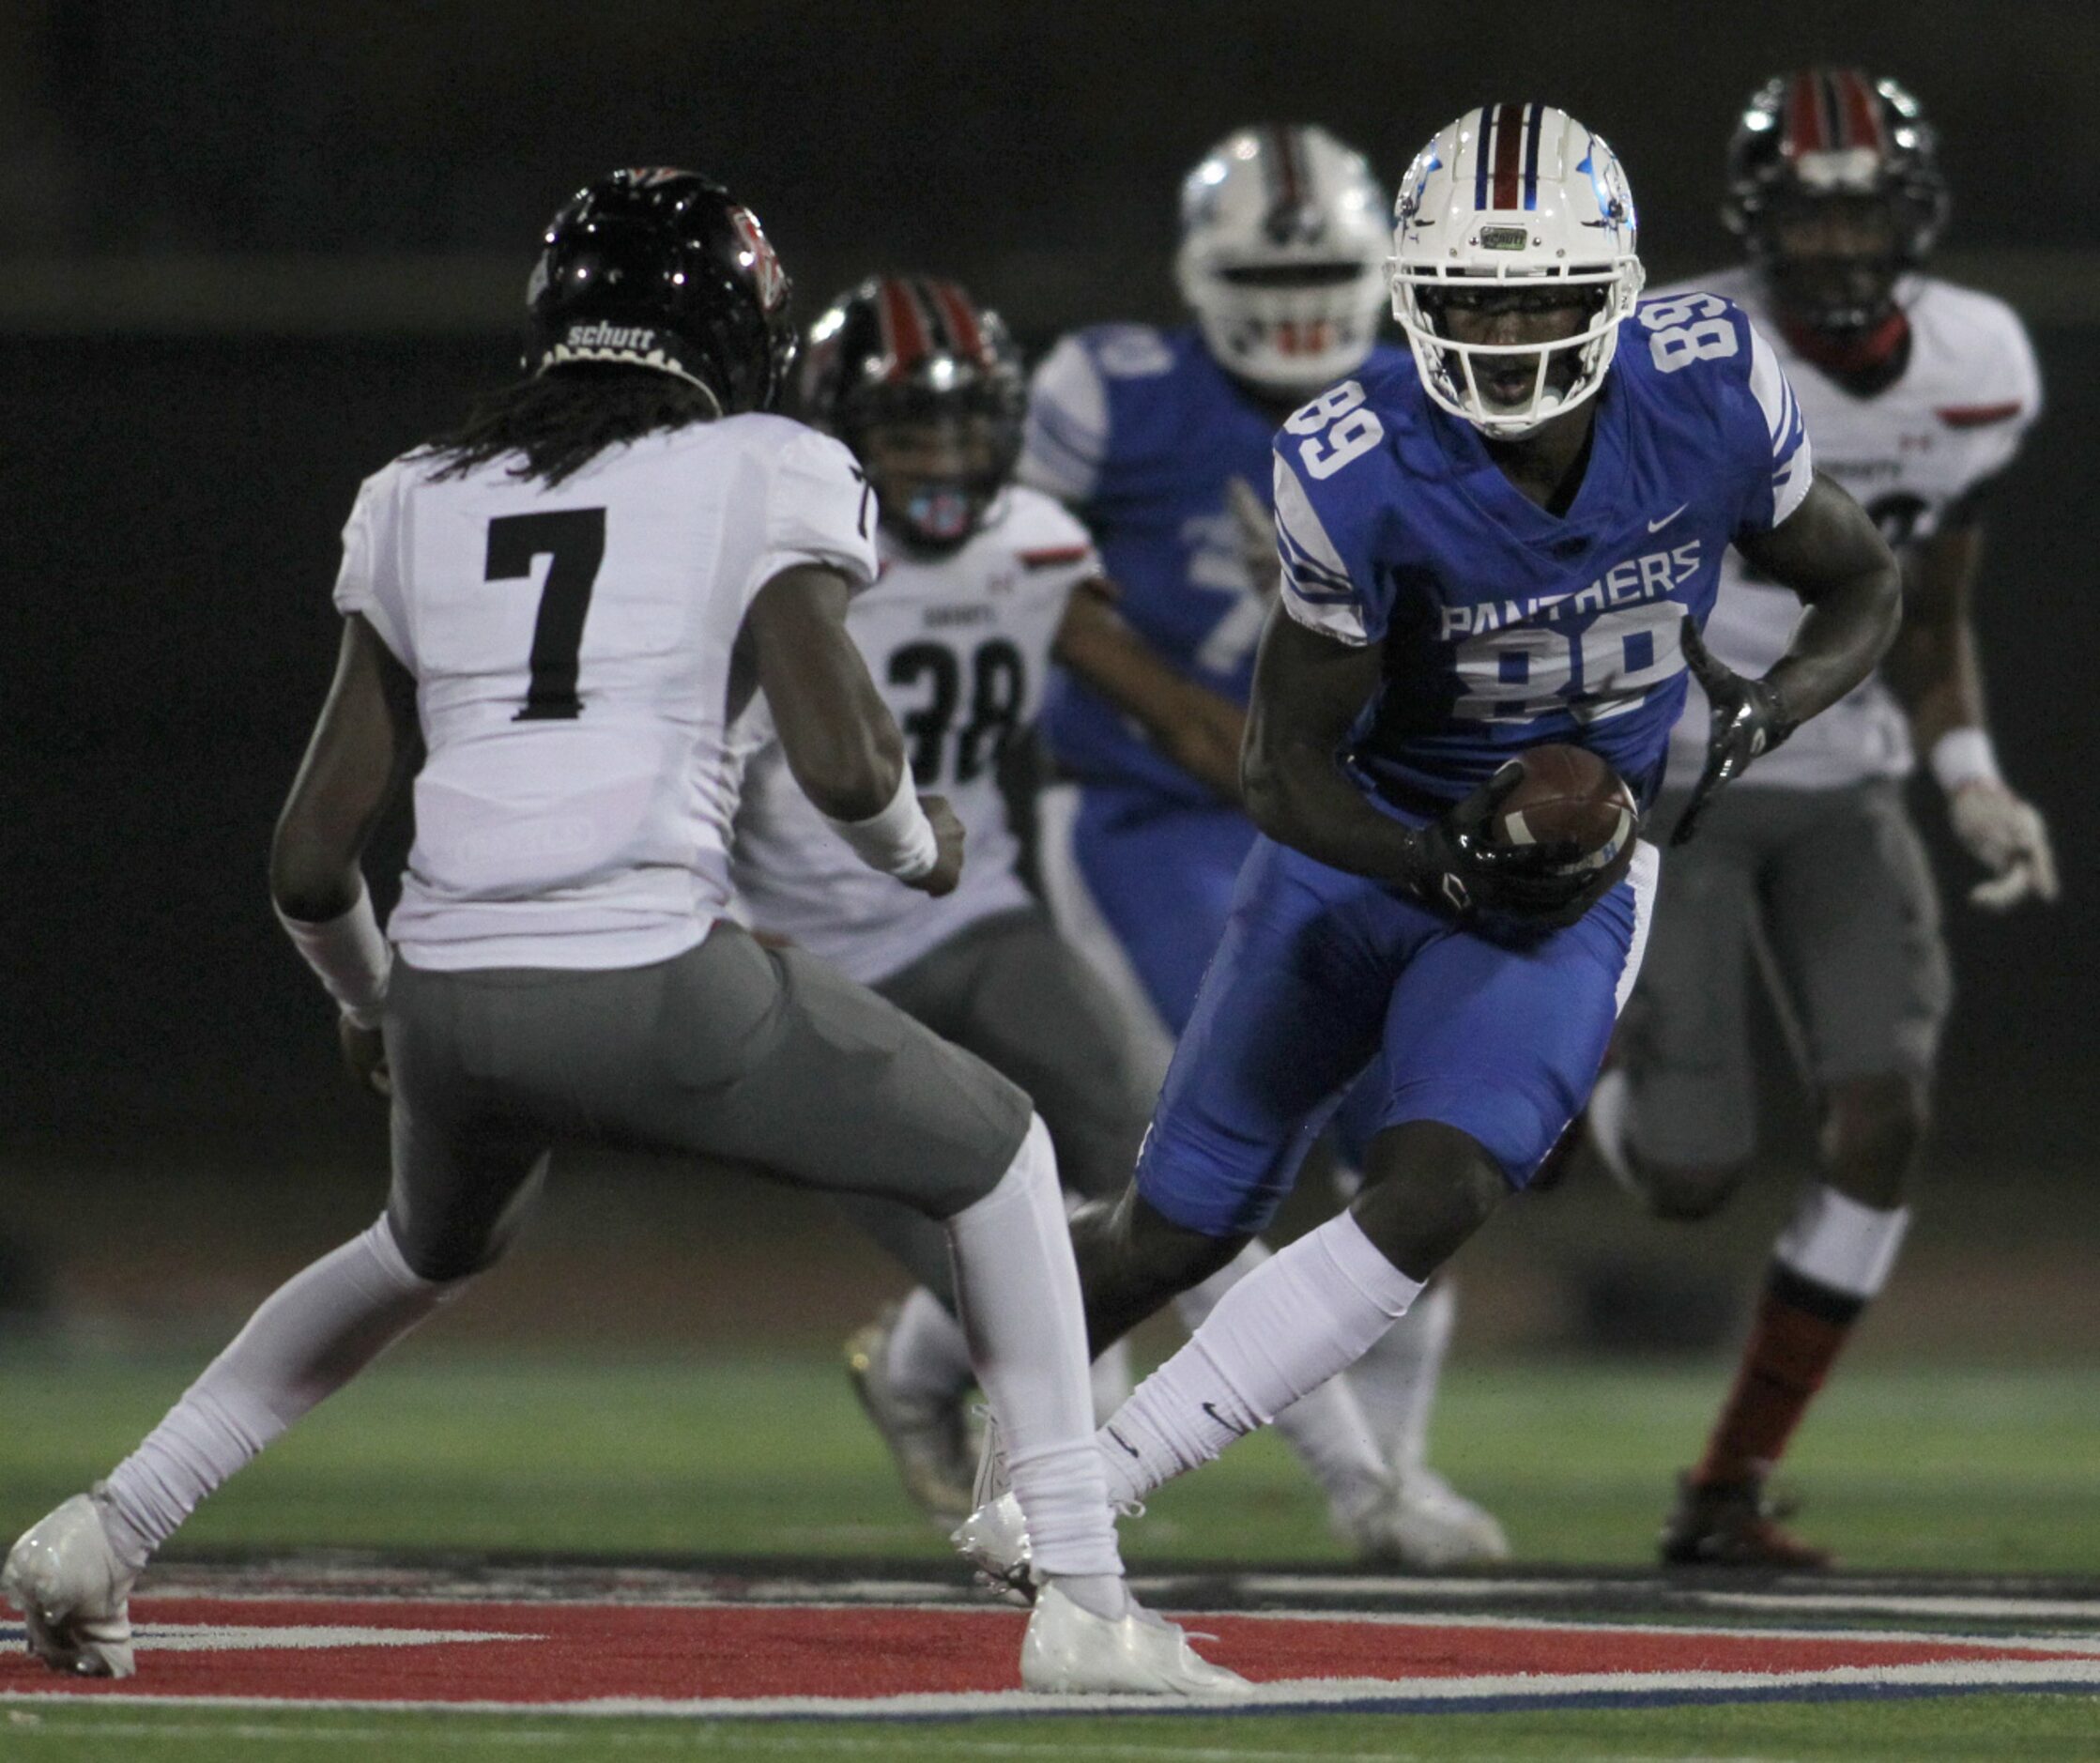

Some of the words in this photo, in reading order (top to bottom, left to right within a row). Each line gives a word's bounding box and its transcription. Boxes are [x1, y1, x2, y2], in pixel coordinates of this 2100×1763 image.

[567, 319, 654, 351] schutt
[1637, 292, 1739, 374] 89
[1282, 379, 1385, 481] 89
[484, 507, 608, 722] 7
[1440, 540, 1701, 642] PANTHERS
